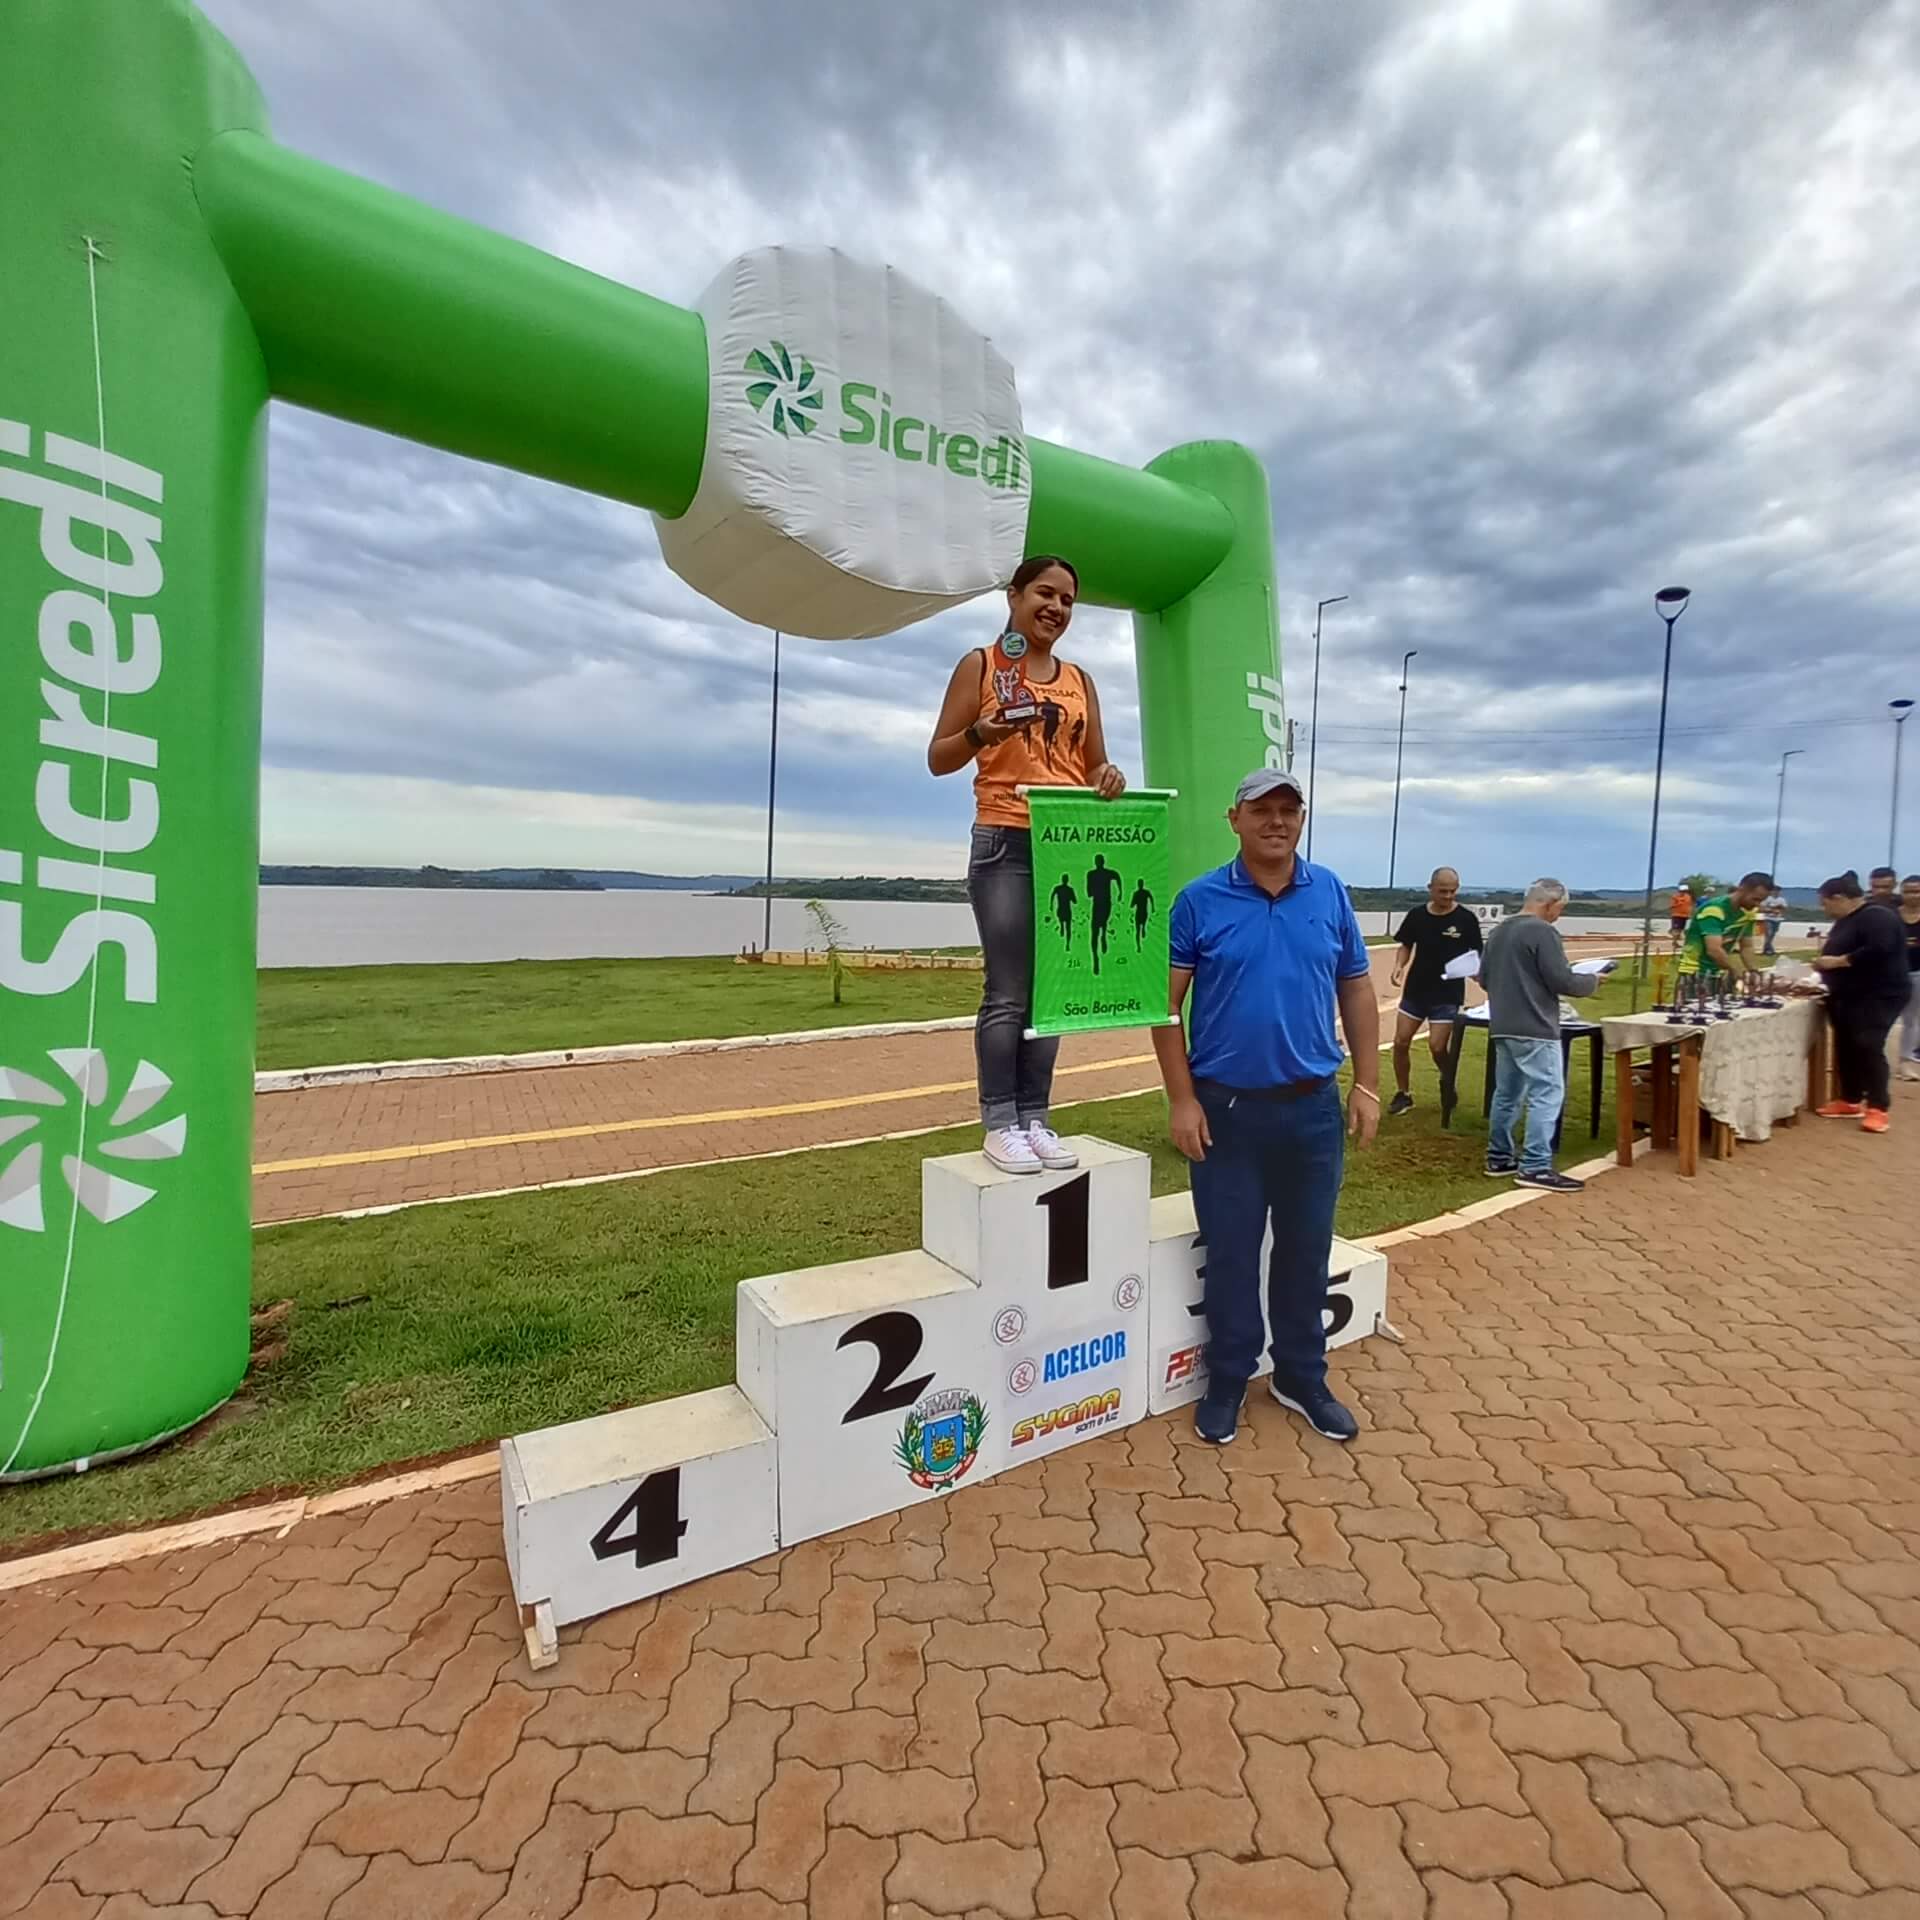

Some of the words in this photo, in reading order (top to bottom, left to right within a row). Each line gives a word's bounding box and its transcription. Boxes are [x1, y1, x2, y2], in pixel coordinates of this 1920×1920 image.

[840, 382, 1022, 490] Sicredi
[0, 418, 163, 1004] Sicredi
[1041, 826, 1080, 842] ALTA
[1086, 824, 1155, 843] PRESSÃO
[1063, 1003, 1088, 1016] São
[1036, 1171, 1090, 1289] 1
[836, 1312, 936, 1424] 2
[1044, 1331, 1126, 1384] ACELCOR
[1011, 1388, 1121, 1447] SYGMA
[590, 1467, 688, 1568] 4
